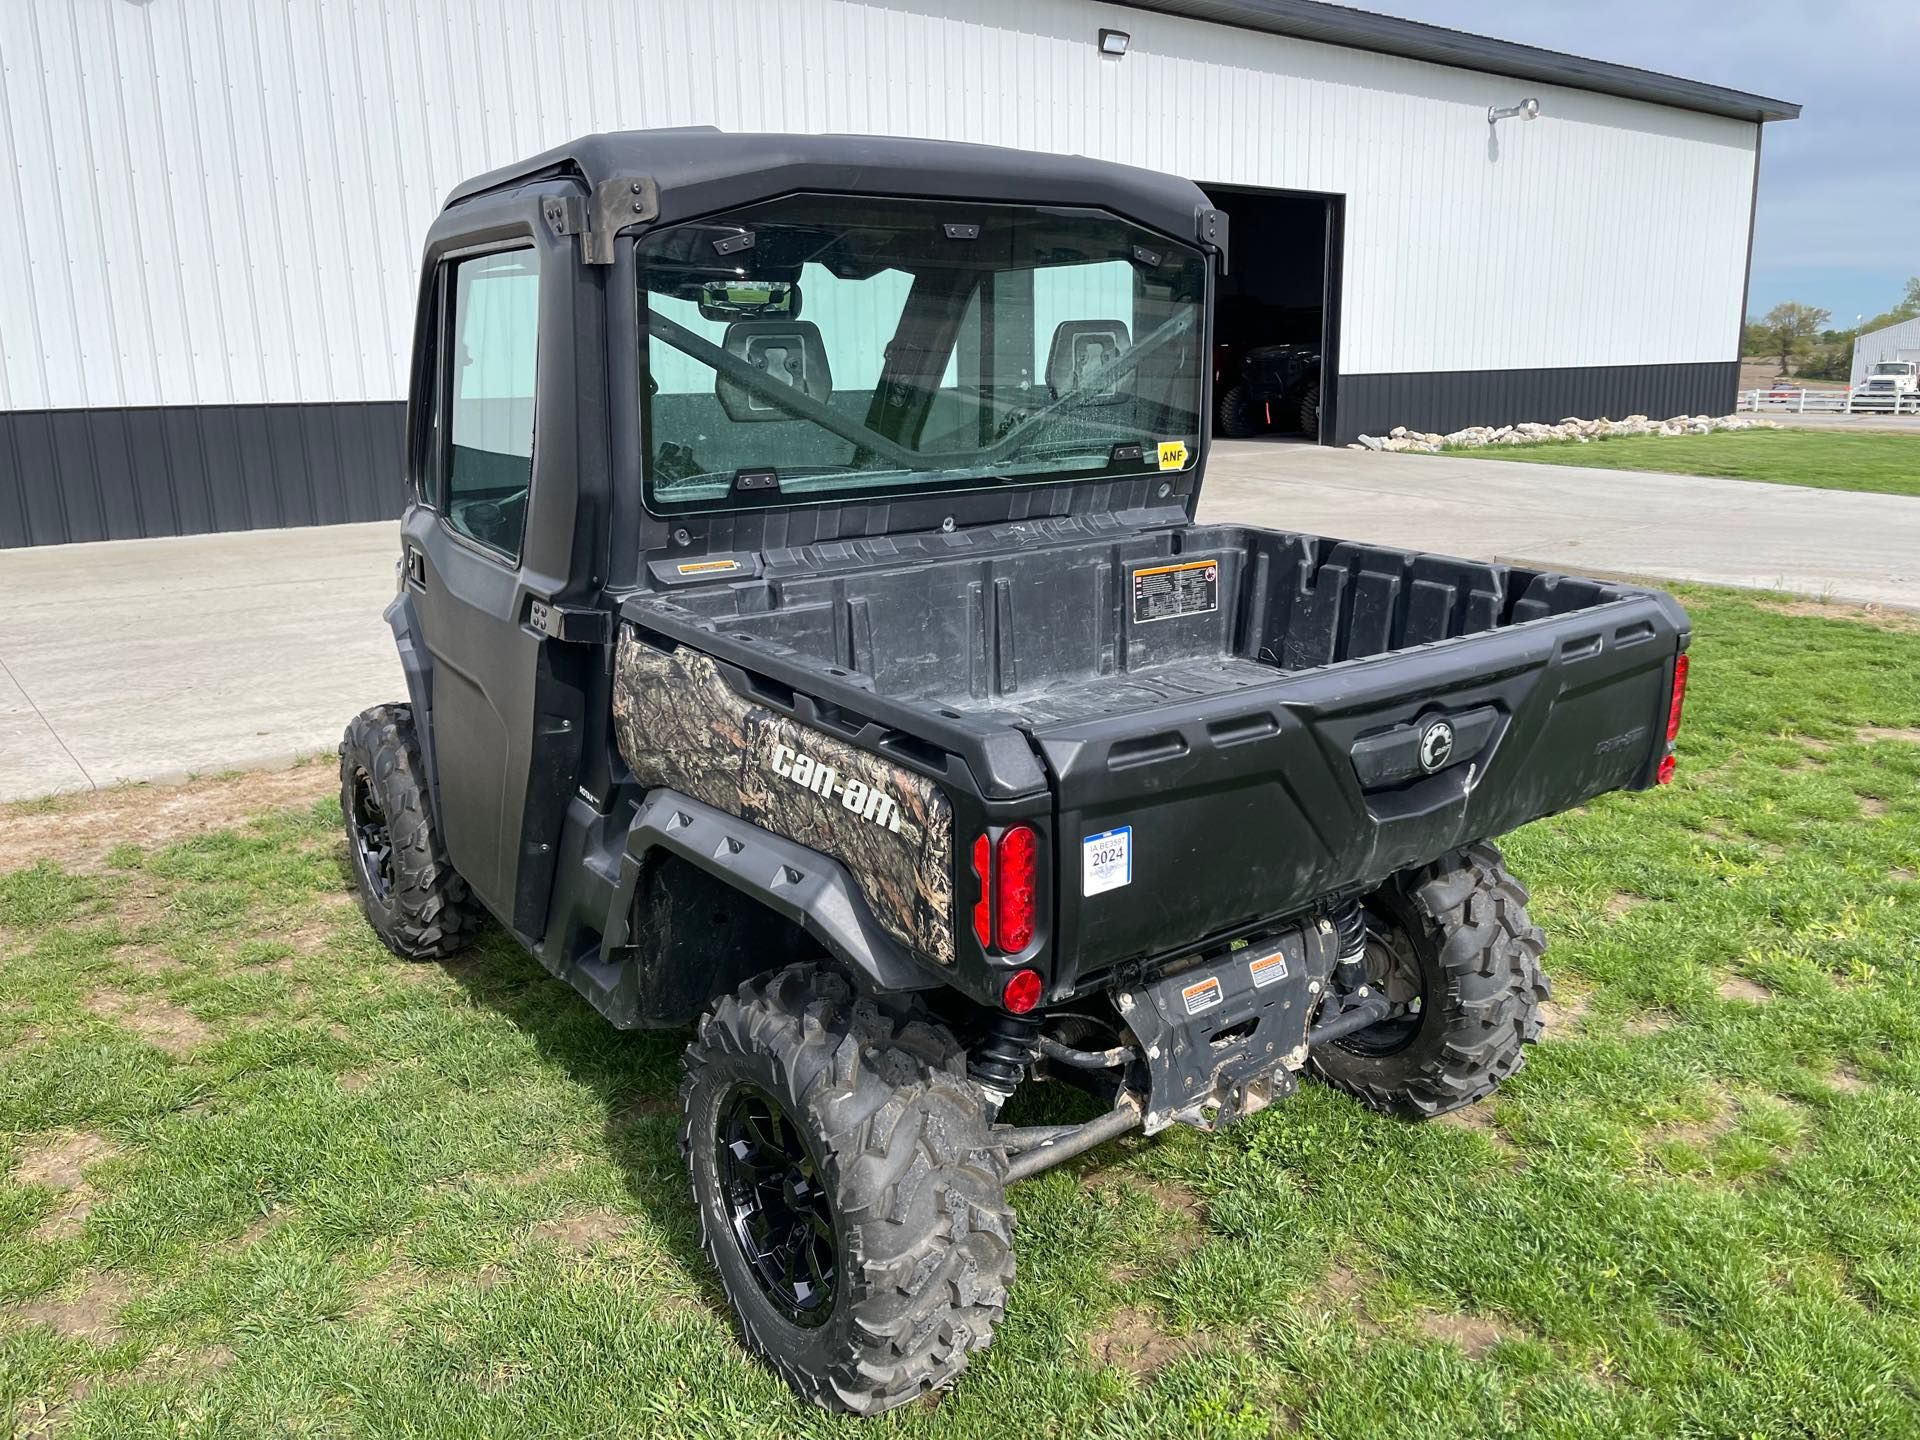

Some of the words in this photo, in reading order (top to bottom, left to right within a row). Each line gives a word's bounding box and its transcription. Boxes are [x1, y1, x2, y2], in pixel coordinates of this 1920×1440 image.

[1161, 450, 1183, 463] ANF
[772, 743, 901, 834] can-am
[1092, 846, 1124, 867] 2024
